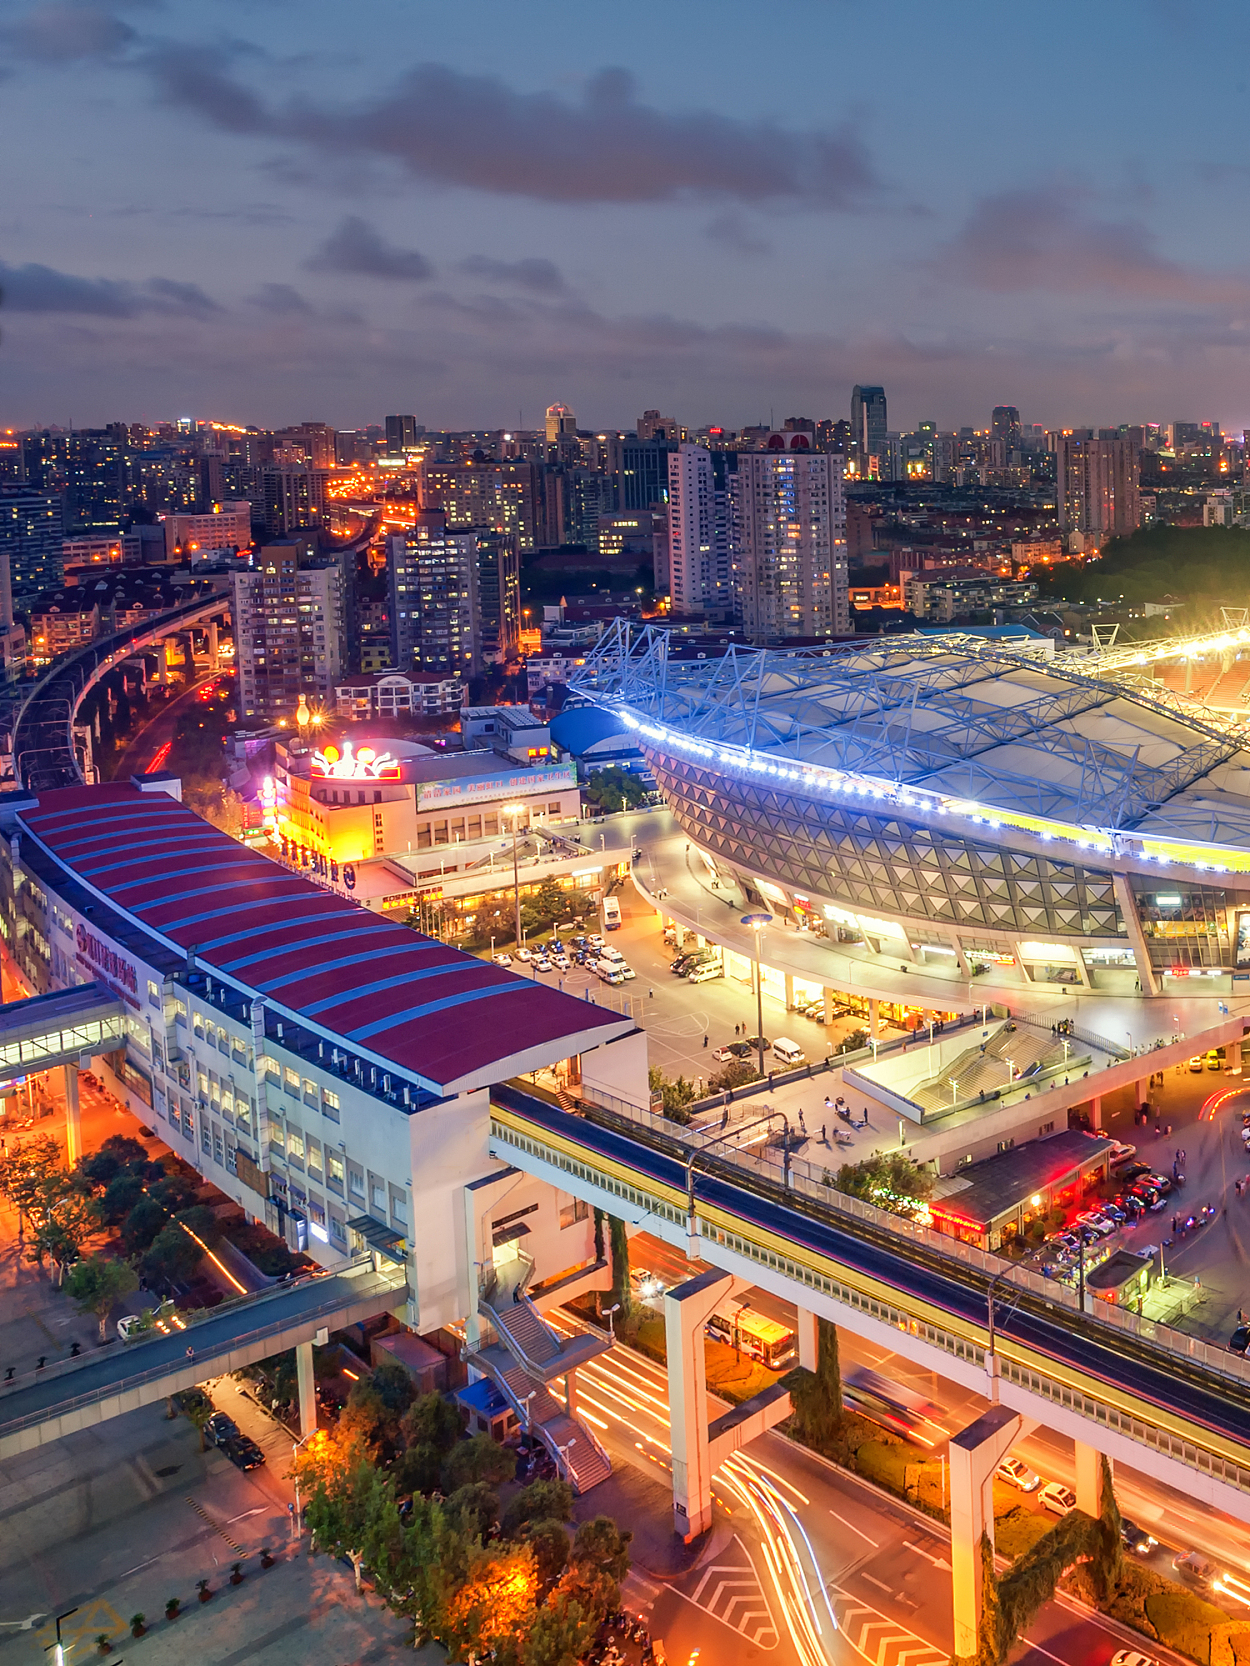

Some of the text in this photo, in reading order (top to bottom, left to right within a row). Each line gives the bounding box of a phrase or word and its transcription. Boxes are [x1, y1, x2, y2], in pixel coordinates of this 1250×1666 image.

[467, 780, 503, 793] 美丽虹口
[509, 769, 571, 787] 创建国家卫生区
